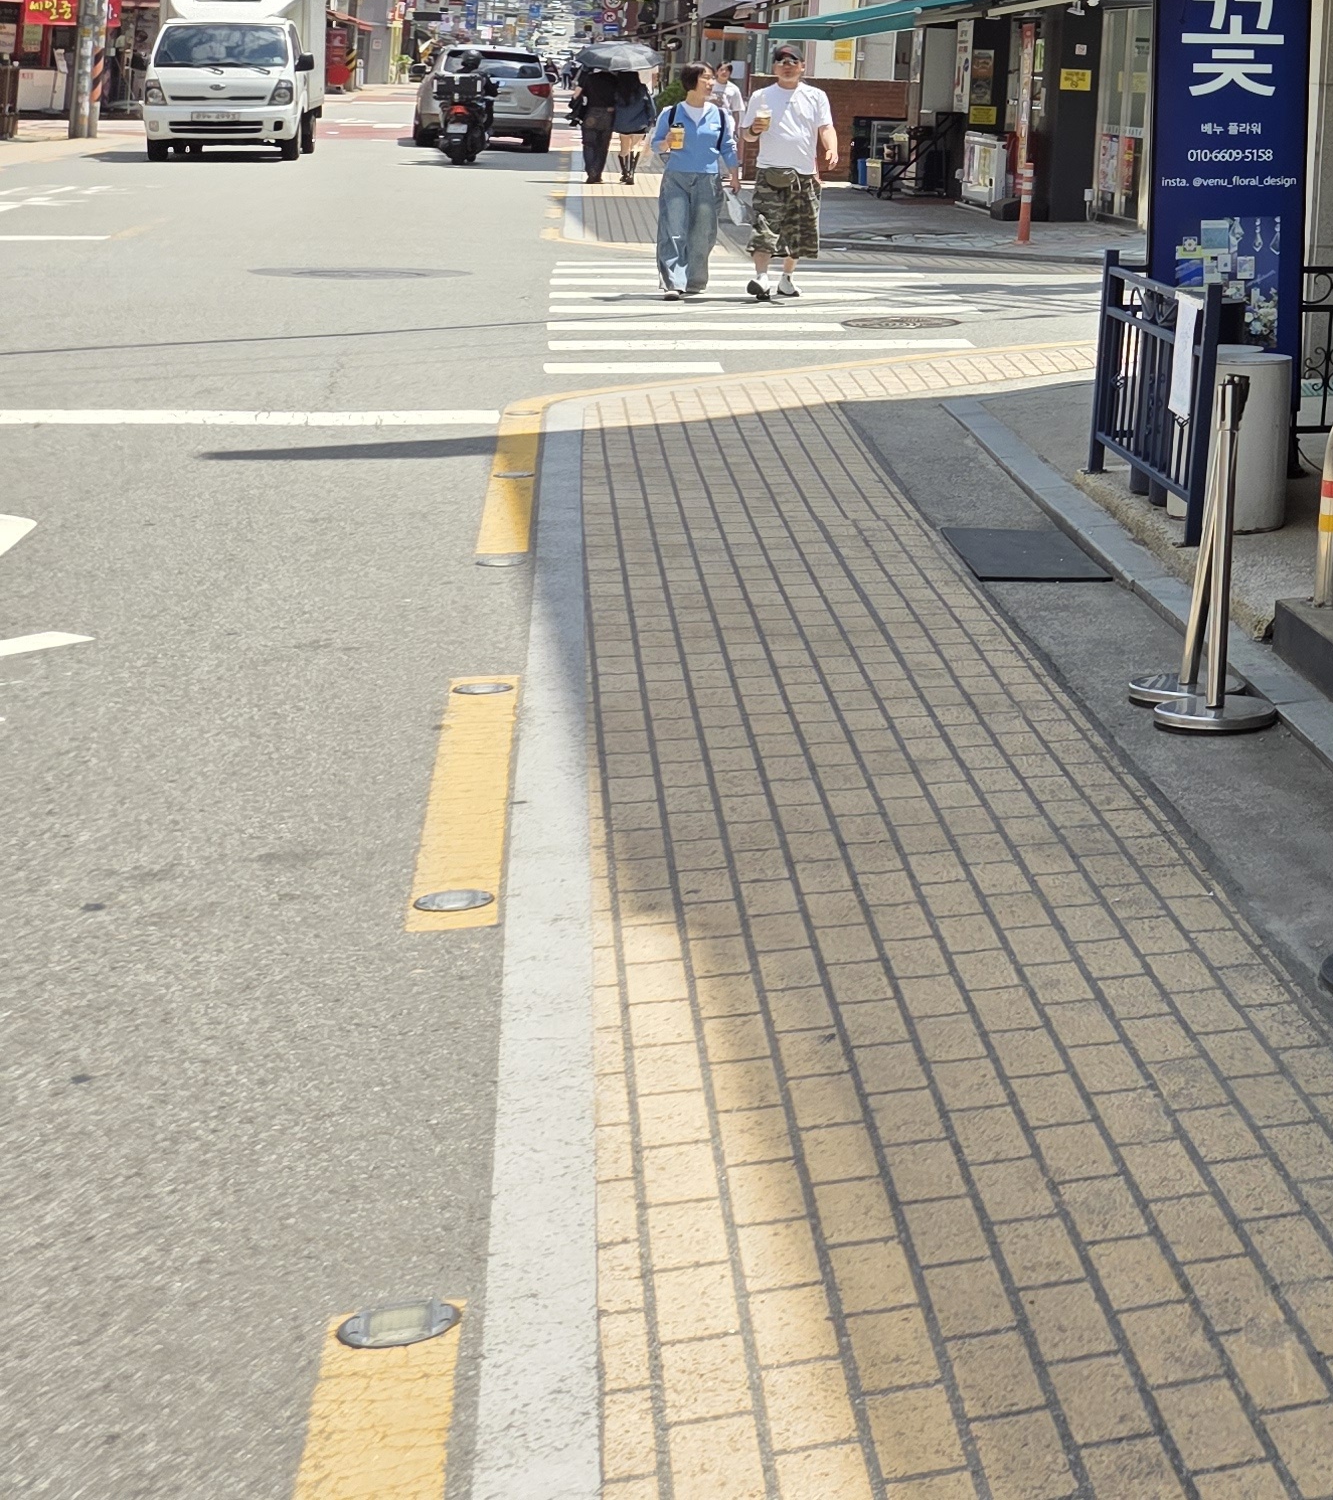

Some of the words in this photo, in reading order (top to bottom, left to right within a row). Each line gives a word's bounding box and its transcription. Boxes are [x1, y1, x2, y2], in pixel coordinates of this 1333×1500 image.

[1201, 123, 1224, 135] 베누
[1228, 123, 1262, 135] 플라워
[1161, 177, 1190, 187] insta.
[1193, 176, 1297, 188] @venu_floral_design
